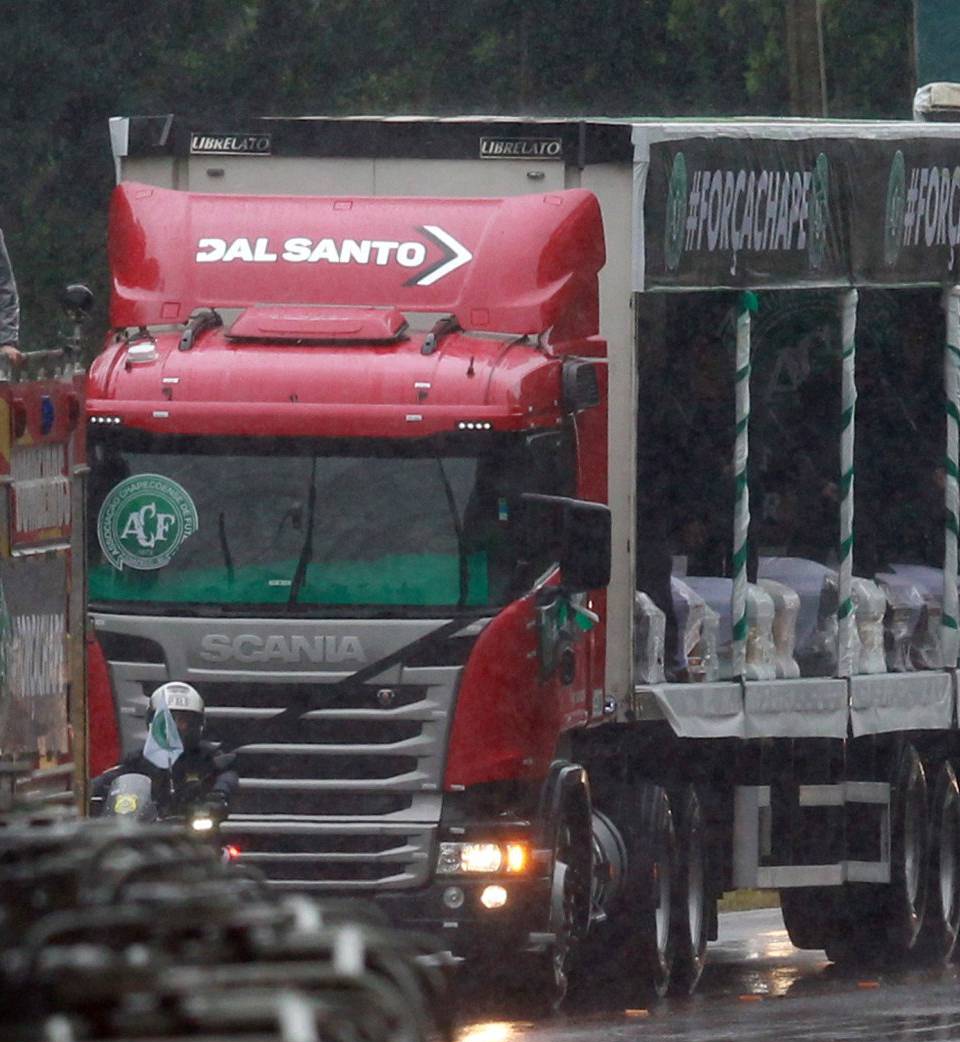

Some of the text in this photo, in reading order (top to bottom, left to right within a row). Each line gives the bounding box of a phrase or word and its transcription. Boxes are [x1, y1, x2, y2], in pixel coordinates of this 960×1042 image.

[191, 135, 270, 152] LIBRELATO
[481, 139, 561, 156] LIBRELATO
[196, 238, 427, 268] DAL SANTO
[201, 633, 368, 664] SCANIA
